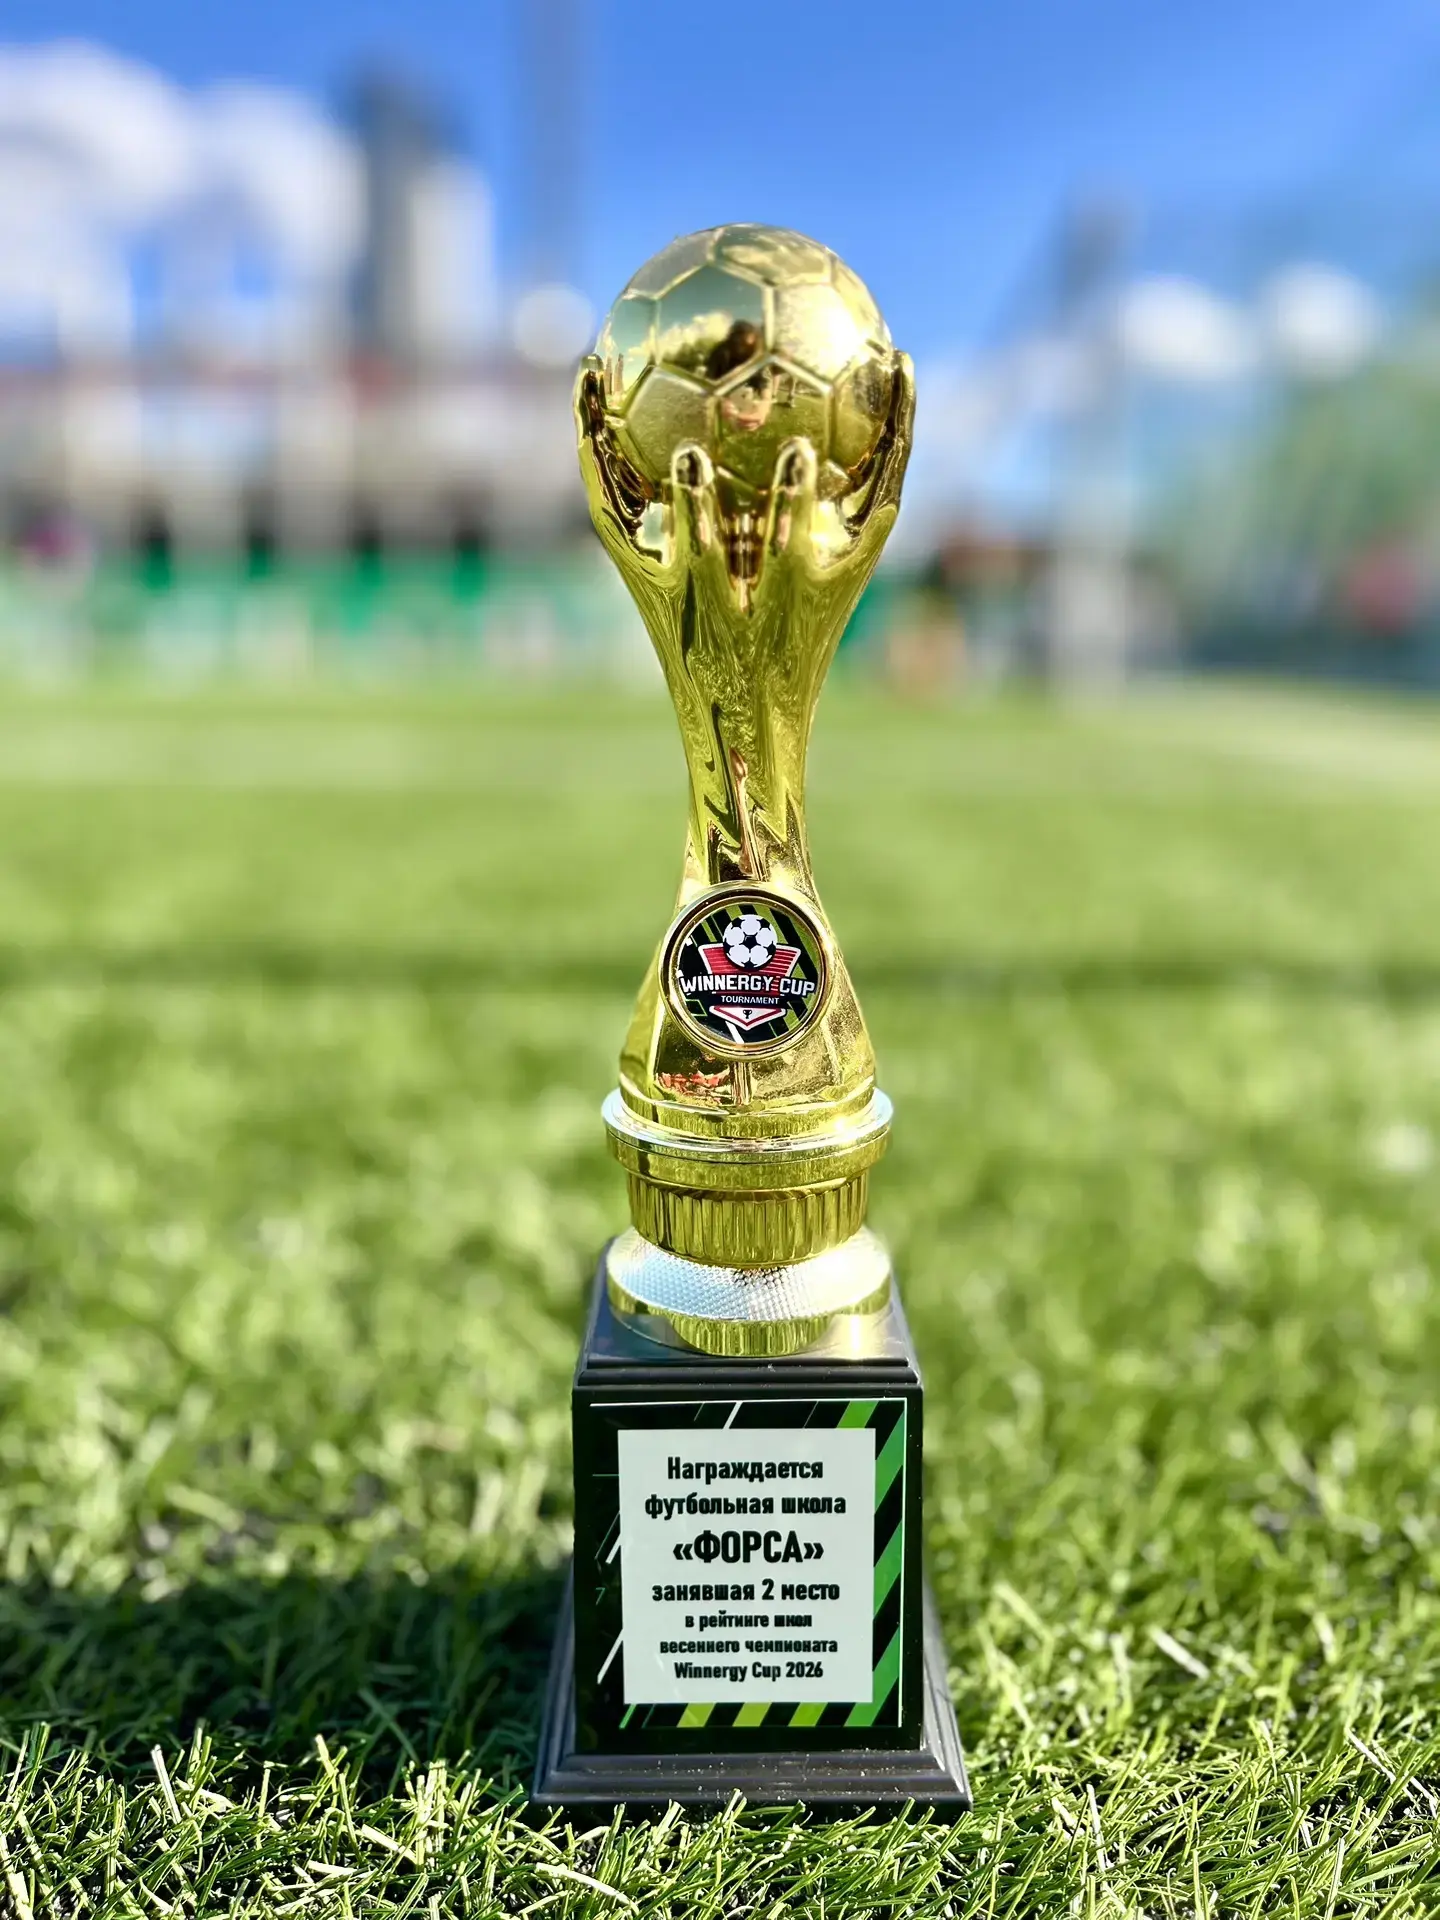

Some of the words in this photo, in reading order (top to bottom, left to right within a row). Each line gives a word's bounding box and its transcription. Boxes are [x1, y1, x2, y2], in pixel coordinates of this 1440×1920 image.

[680, 975, 774, 993] WINNERGY
[780, 978, 815, 996] CUP
[721, 995, 780, 1005] TOURNAMENT
[668, 1457, 823, 1485] Награждается
[645, 1492, 773, 1520] футбольная
[782, 1497, 846, 1513] школа
[673, 1530, 824, 1563] «ФОРСА»
[652, 1584, 754, 1601] занявшая
[762, 1579, 774, 1600] 2
[782, 1584, 839, 1600] место
[685, 1616, 694, 1627] в
[700, 1610, 769, 1631] рейтинге
[774, 1615, 812, 1627] школ
[660, 1641, 740, 1653] весеннего
[745, 1641, 837, 1652] чемпионата
[675, 1662, 747, 1682] Winnergy
[752, 1662, 780, 1682] Cup
[786, 1662, 823, 1677] 2026
